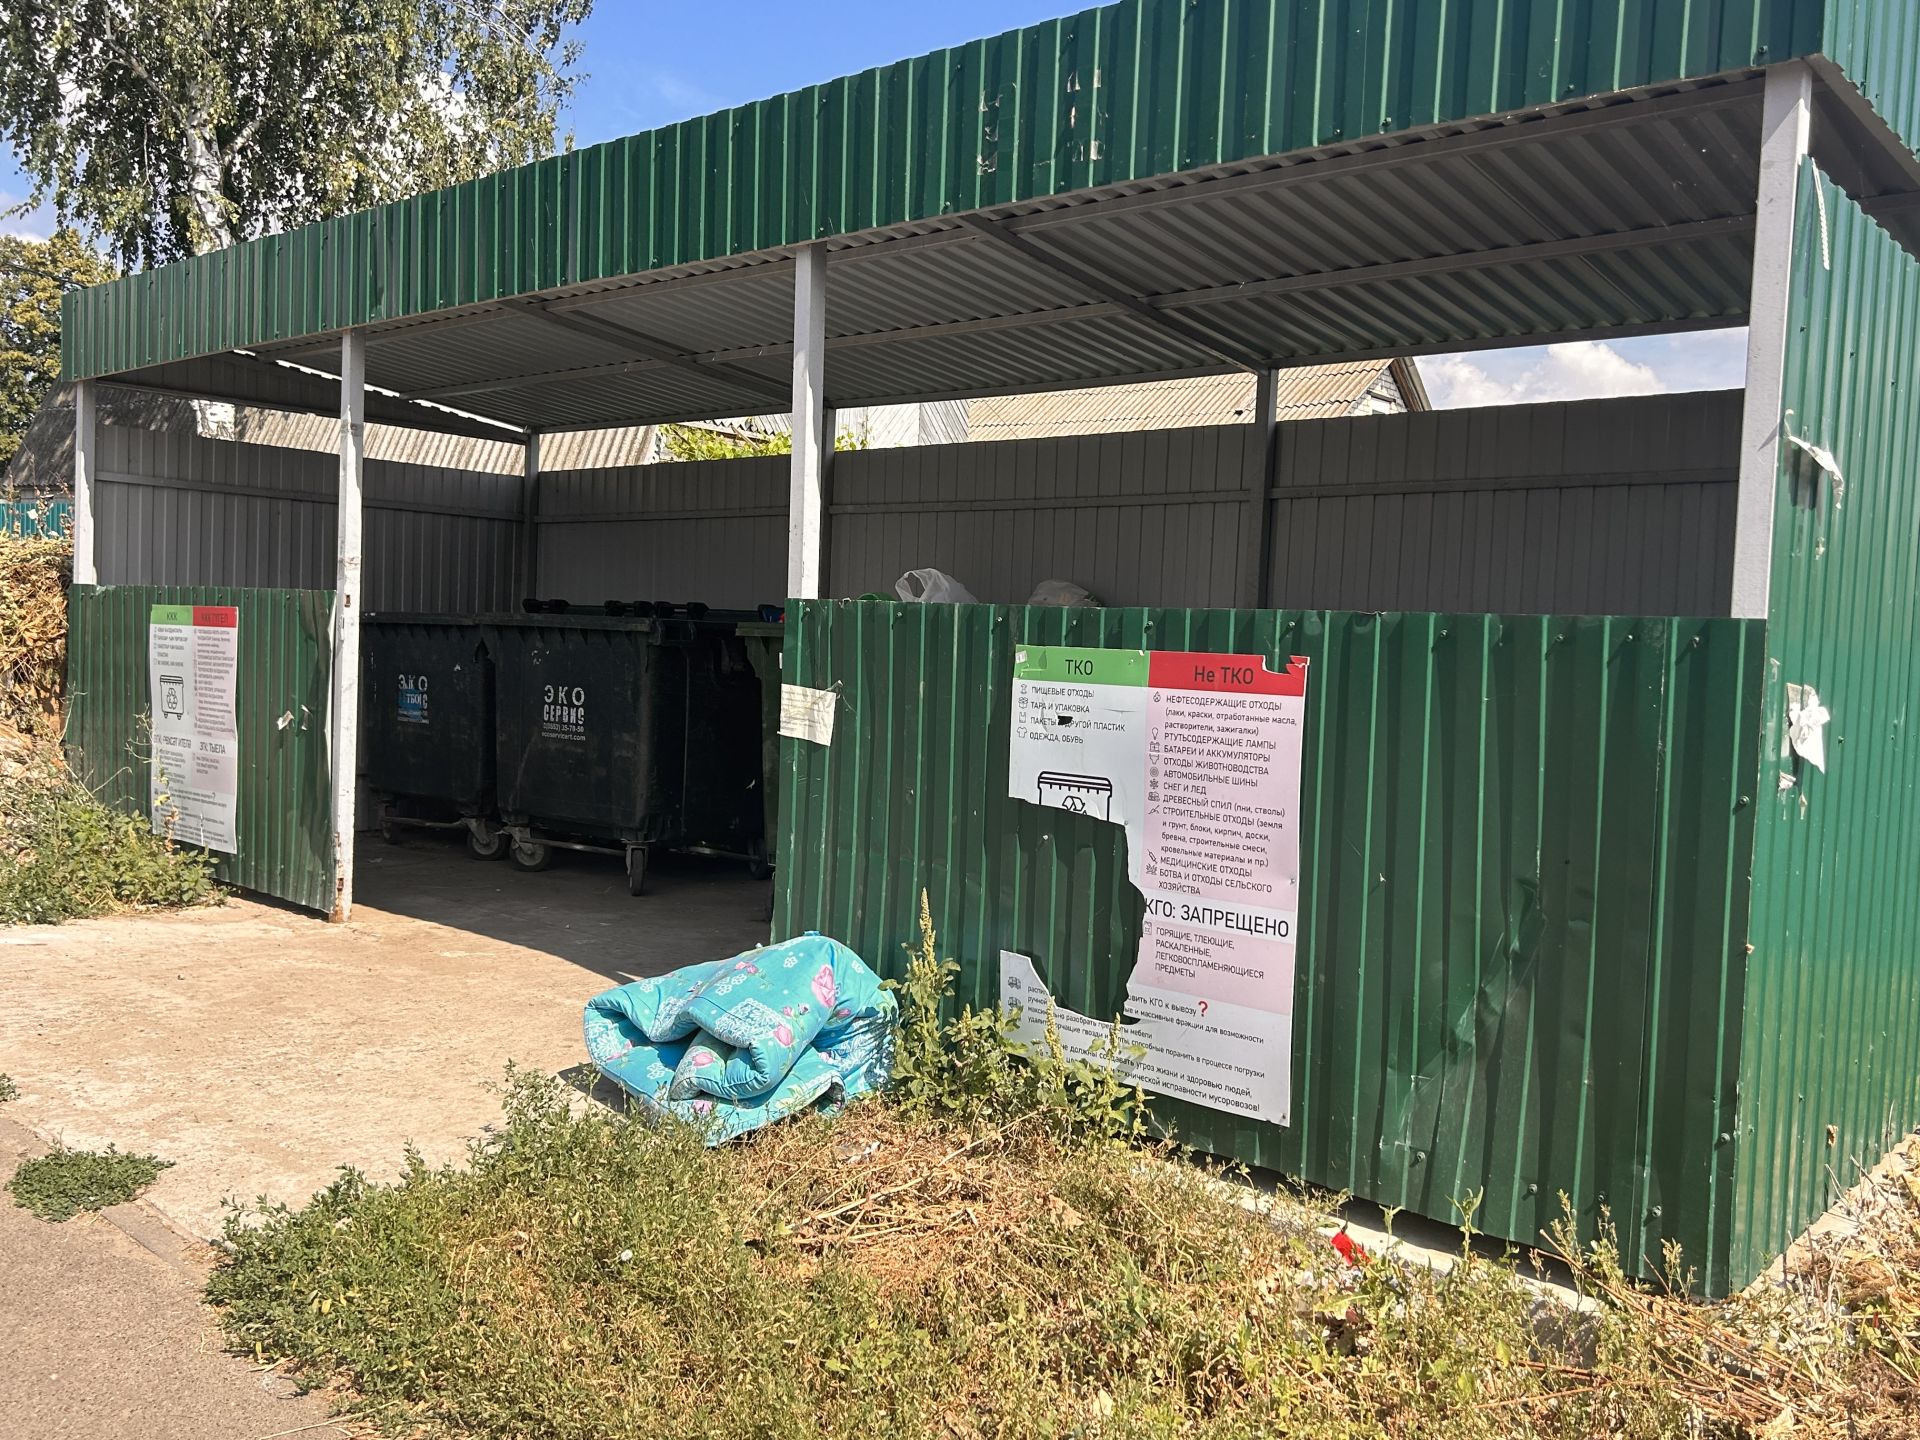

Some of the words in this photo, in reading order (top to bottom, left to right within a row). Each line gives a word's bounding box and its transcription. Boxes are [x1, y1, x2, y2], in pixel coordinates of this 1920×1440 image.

[1065, 659, 1094, 676] ТКО
[1194, 665, 1215, 683] Не
[1221, 667, 1254, 685] ТКО
[544, 684, 585, 706] ЭКО
[1032, 686, 1065, 696] ПИЩЕВЫЕ
[1067, 689, 1095, 698] ОТХОДЫ
[1031, 701, 1046, 710] ТАРА
[1055, 704, 1090, 713] УПАКОВКА
[1166, 695, 1247, 709] НЕФТЕСОДЕРЖАЩИЕ
[1249, 701, 1282, 711] ОТХОДЫ
[543, 704, 585, 725] СЕРВИС
[1031, 716, 1057, 726] ПАКЕТЫ
[1093, 721, 1126, 732] ПЛАСТИК
[1165, 707, 1186, 718] (лаки,
[1187, 711, 1214, 721] краски,
[1216, 713, 1270, 723] отработанные
[1271, 716, 1297, 726] масла,
[1029, 732, 1061, 742] ОДЕЖДА,
[1062, 734, 1084, 744] ОБУВЬ
[1164, 721, 1215, 733] растворители,
[1216, 724, 1259, 736] зажигалки)
[1164, 733, 1244, 748] РТУТЬСОДЕРЖАЩИЕ
[1245, 739, 1277, 750] ЛАМПЫ
[1163, 745, 1197, 756] БАТАРЕИ
[1198, 748, 1204, 756] И
[1206, 749, 1271, 763] АККУМУЛЯТОРЫ
[1163, 757, 1194, 768] ОТХОДЫ
[1195, 760, 1269, 775] ЖИВОТНОВОДСТВА
[1163, 770, 1230, 784] АВТОМОБИЛЬНЫЕ
[1231, 777, 1258, 787] ШИНЫ
[1163, 782, 1182, 791] СНЕГ
[1183, 784, 1189, 792] И
[1190, 785, 1207, 795] ЛЕД
[1163, 795, 1209, 807] ДРЕВЕСНЫЙ
[1210, 800, 1232, 811] СПИЛ
[1234, 802, 1253, 814] (пни,
[1255, 807, 1286, 818] стволы)
[1162, 806, 1220, 821] СТРОИТЕЛЬНЫЕ
[1222, 814, 1255, 827] ОТХОДЫ
[1256, 819, 1283, 830] (земля
[1168, 822, 1188, 831] грунт,
[1190, 823, 1213, 835] блоки,
[1214, 828, 1243, 839] кирпич,
[1245, 832, 1271, 842] доски,
[1161, 832, 1188, 843] бревна,
[1189, 836, 1240, 850] строительные
[1242, 845, 1268, 855] смеси,
[1160, 845, 1203, 858] кровельные
[1204, 853, 1245, 865] материалы
[1160, 856, 1218, 873] МЕДИЦИНСКИЕ
[1220, 865, 1252, 878] ОТХОДЫ
[1159, 868, 1182, 879] БОТВА
[1184, 872, 1190, 880] И
[1191, 872, 1223, 886] ОТХОДЫ
[1225, 878, 1273, 893] СЕЛЬСКОГО
[1159, 880, 1201, 895] ХОЗЯЙСТВА
[1144, 897, 1176, 919] КГО:
[1180, 904, 1290, 938] ЗАПРЕЩЕНО
[1155, 939, 1212, 958] РАСКАЛЕННЫЕ,
[1156, 927, 1193, 942] ГОРЯЩИЕ,
[1194, 934, 1235, 950] ТЛЕЮЩИЕ,
[1155, 951, 1264, 979] ЛЕГКОВОСПЛАМЕНЯЮЩИЕСЯ
[1155, 962, 1196, 979] ПРЕДМЕТЫ
[1149, 997, 1164, 1008] КГО
[1171, 1003, 1197, 1016] вывозу
[1066, 1014, 1097, 1027] разобрать
[1130, 1027, 1153, 1039] мебели
[1140, 1010, 1175, 1024] массивные
[1175, 1018, 1204, 1031] фракции
[1205, 1025, 1218, 1034] для
[1219, 1027, 1265, 1044] возможности
[1131, 1039, 1165, 1053] способные
[1165, 1048, 1195, 1062] поранить
[1202, 1057, 1233, 1071] процессе
[1234, 1065, 1265, 1079] погрузки
[1099, 1052, 1135, 1066] содавать
[1136, 1060, 1155, 1072] угроз
[1156, 1067, 1179, 1079] жизни
[1186, 1074, 1223, 1091] здоровью
[1225, 1084, 1253, 1099] людей,
[1162, 1081, 1207, 1099] исправности
[1208, 1093, 1260, 1112] мусоровозов!
